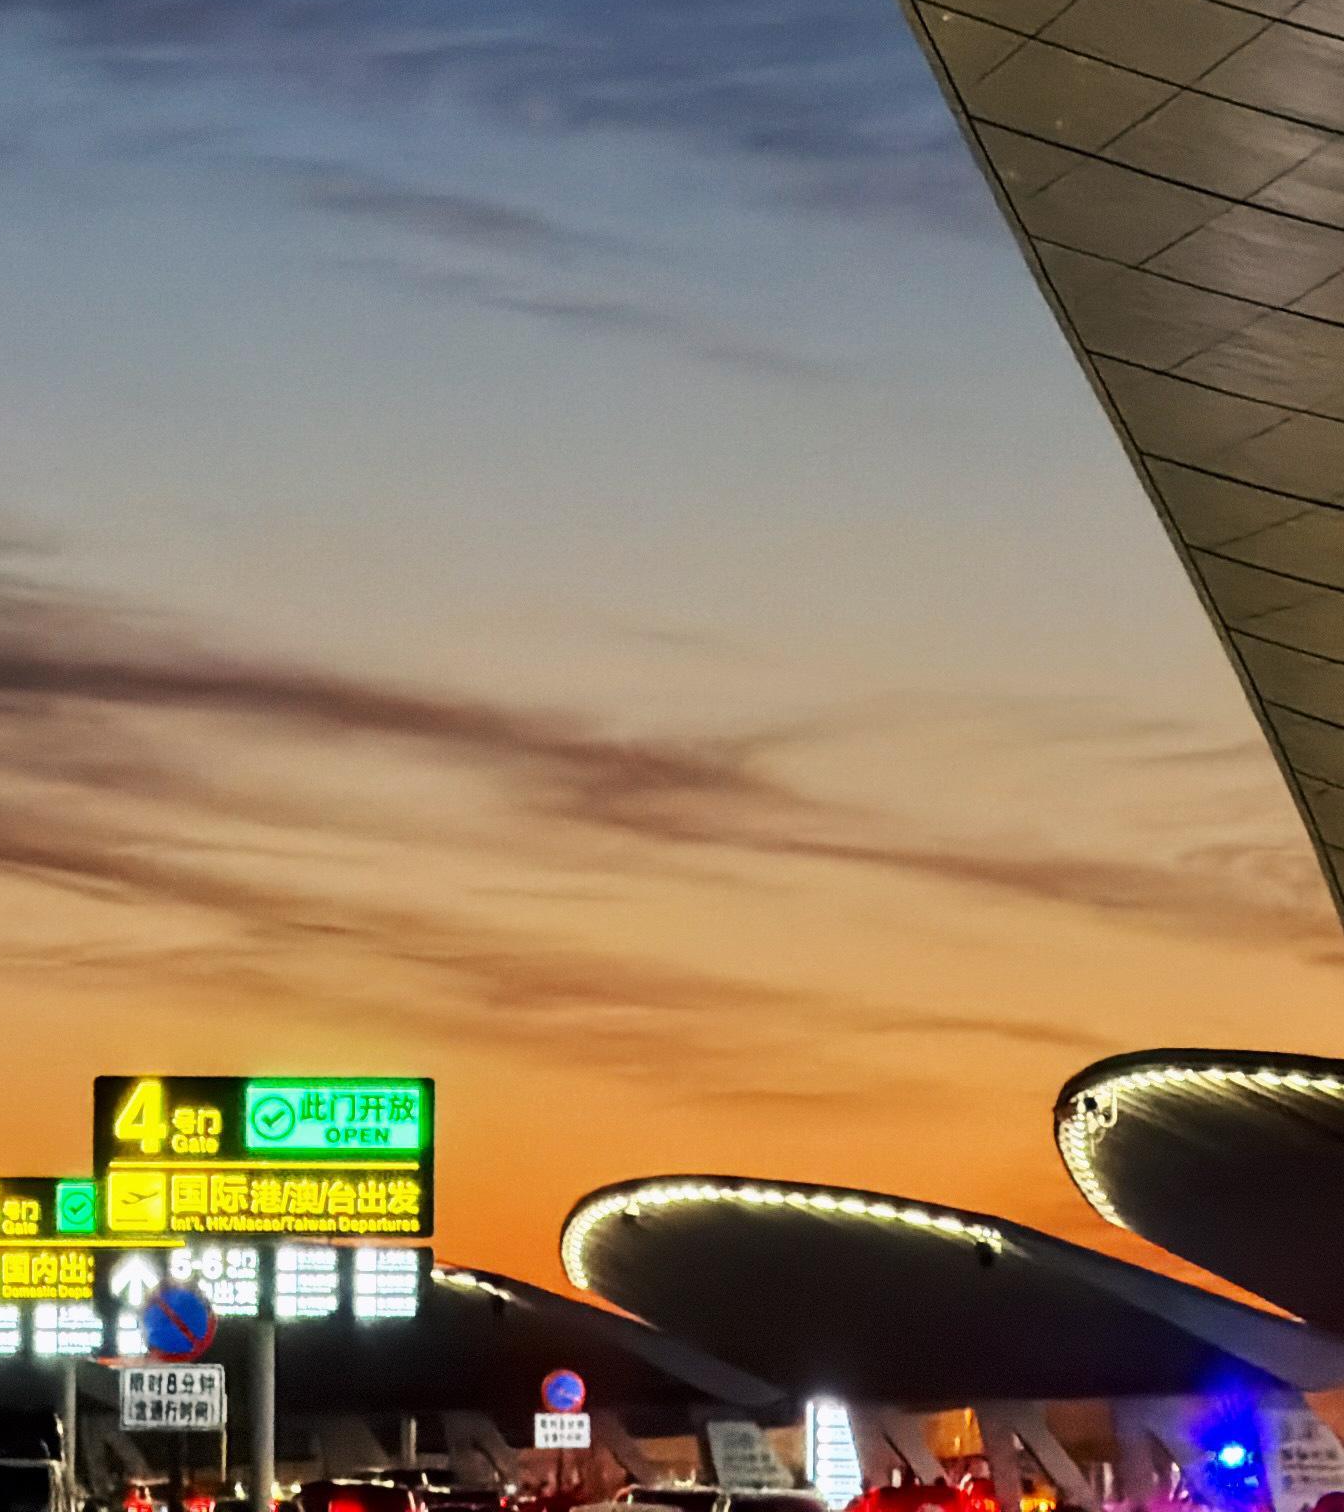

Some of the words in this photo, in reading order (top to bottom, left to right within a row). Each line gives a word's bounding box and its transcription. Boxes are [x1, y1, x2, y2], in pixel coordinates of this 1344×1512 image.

[114, 1080, 168, 1154] 4
[299, 1093, 415, 1122] 此门开放
[171, 1136, 219, 1154] Gate
[326, 1128, 391, 1144] OPEN
[207, 1217, 336, 1232] HK/Macao/Taiwan
[340, 1217, 420, 1233] Departures
[2, 1252, 94, 1285] 国内出
